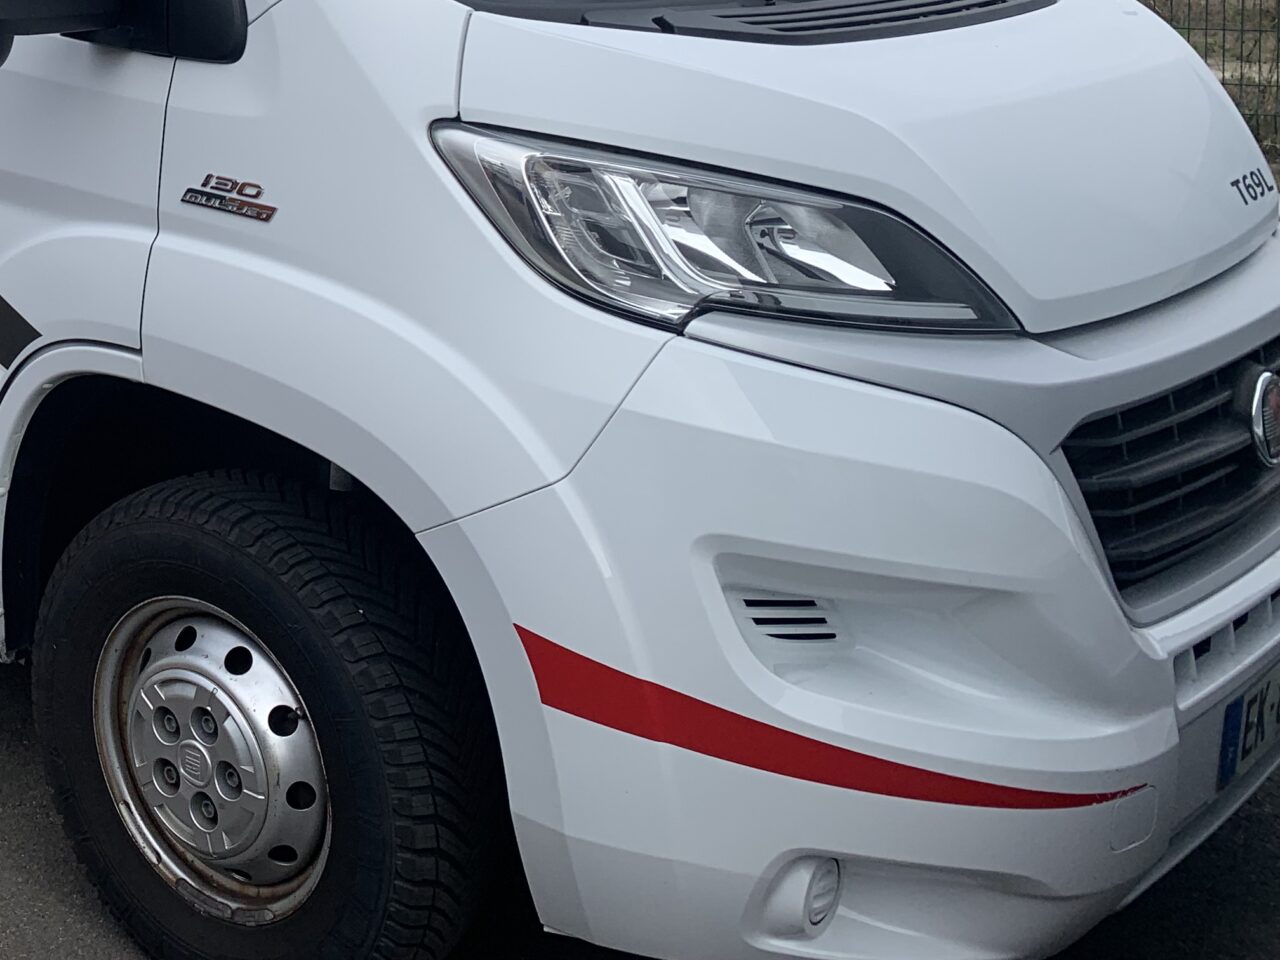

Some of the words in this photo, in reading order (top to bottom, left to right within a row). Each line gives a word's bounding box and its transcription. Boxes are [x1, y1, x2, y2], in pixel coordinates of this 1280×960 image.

[200, 173, 264, 200] 130
[1230, 167, 1274, 206] T69L
[1240, 680, 1280, 762] EK-
